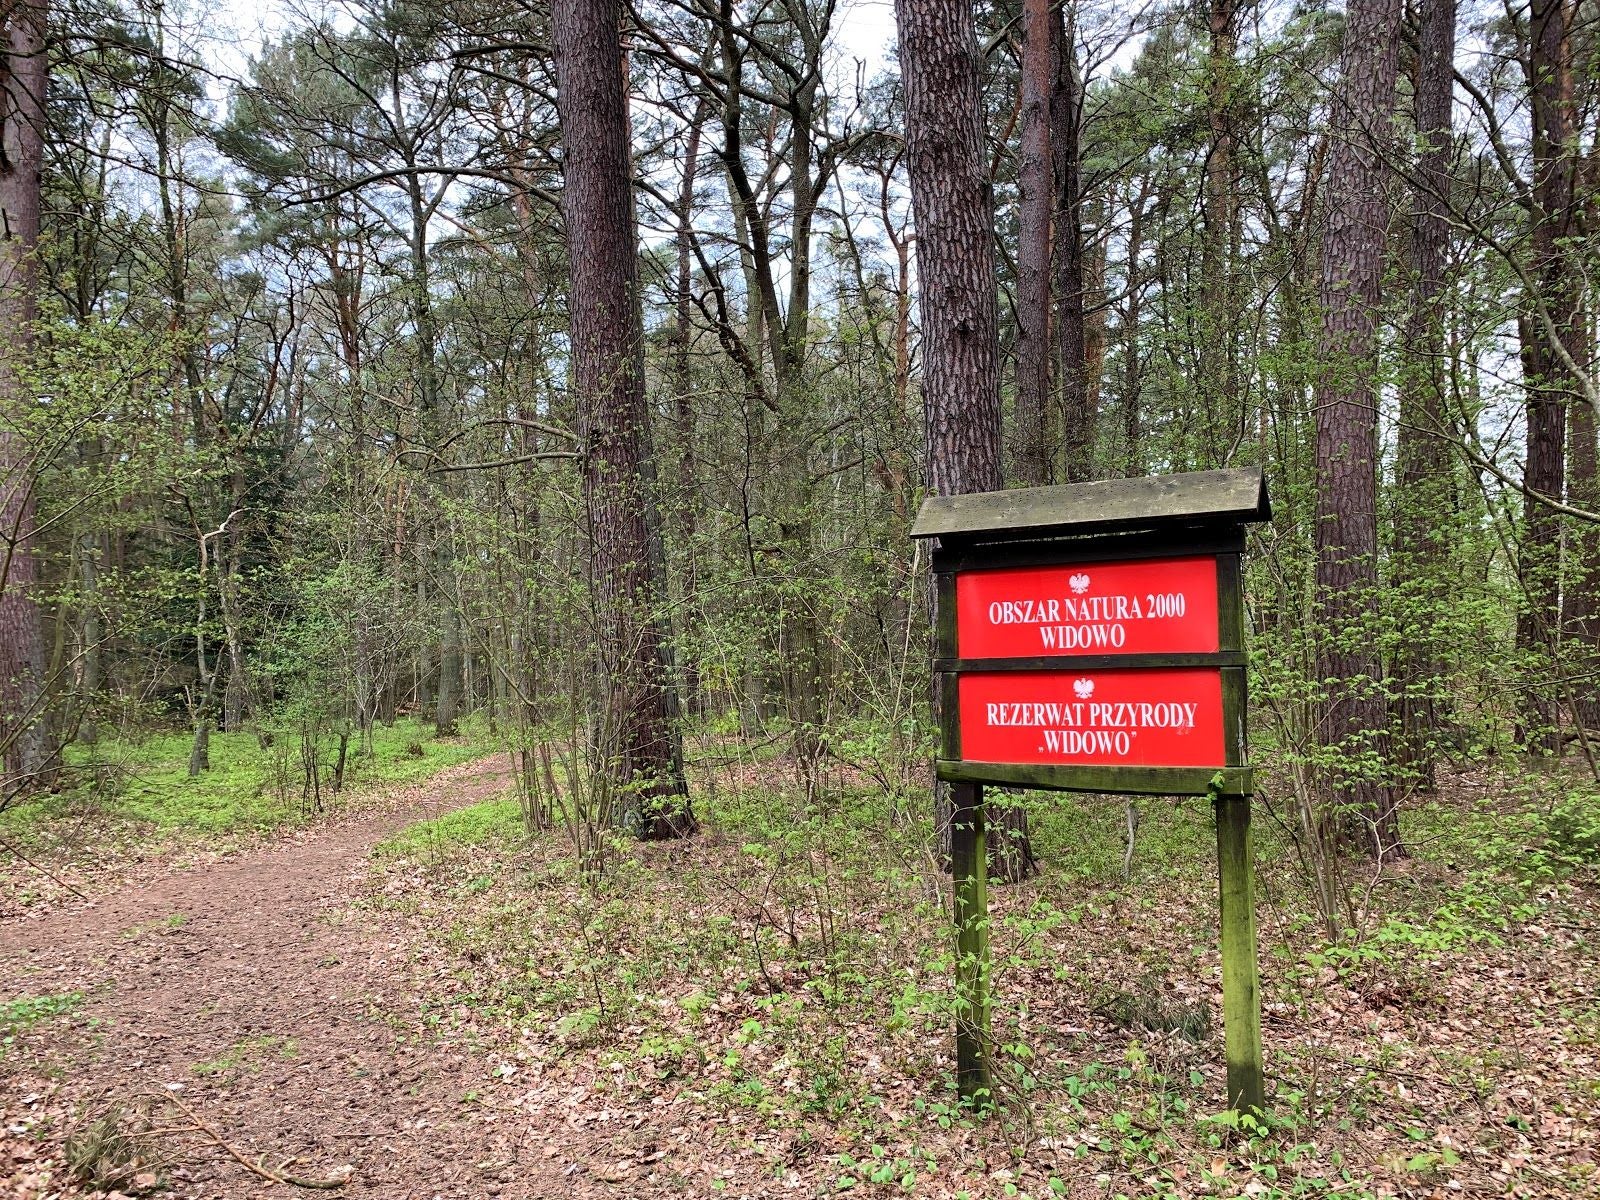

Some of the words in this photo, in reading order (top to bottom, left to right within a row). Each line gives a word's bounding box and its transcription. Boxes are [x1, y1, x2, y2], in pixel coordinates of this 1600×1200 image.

[990, 600, 1060, 624] OBSZAR
[1065, 596, 1142, 621] NATURA
[1147, 593, 1185, 618] 2000
[1040, 624, 1125, 648] WIDOWO
[987, 703, 1084, 727] REZERWAT
[1090, 703, 1197, 728] PRZYRODY
